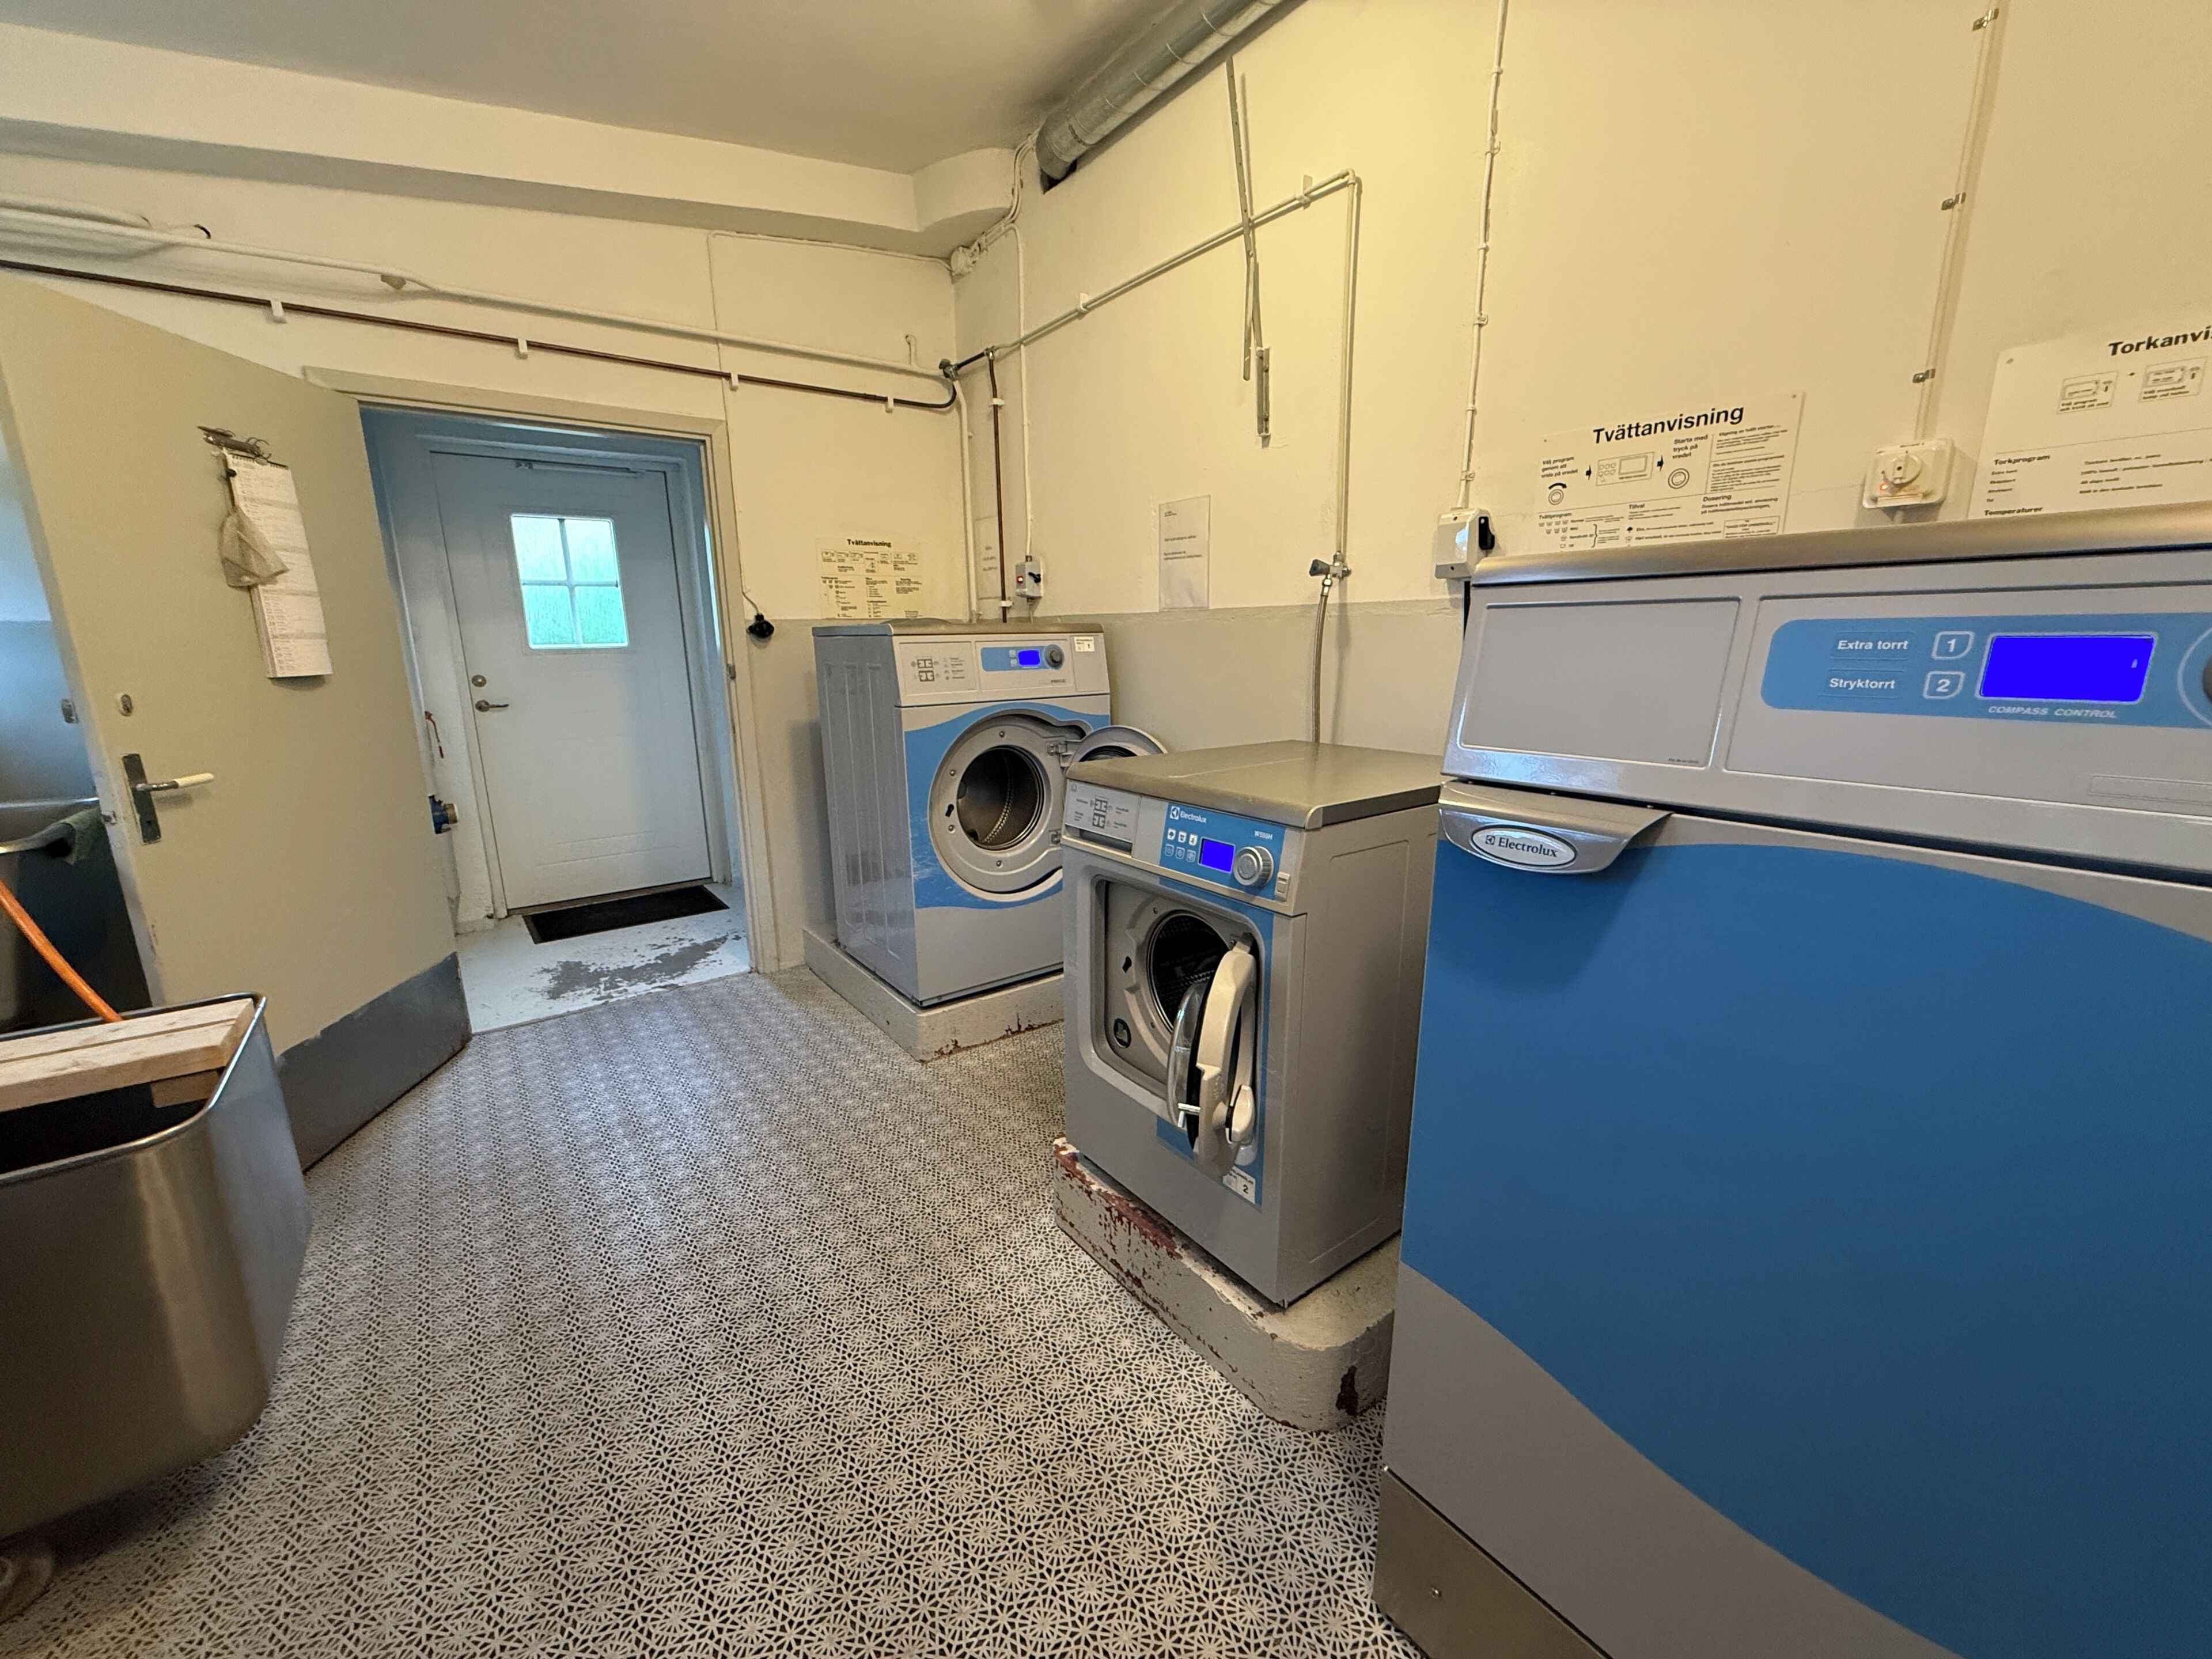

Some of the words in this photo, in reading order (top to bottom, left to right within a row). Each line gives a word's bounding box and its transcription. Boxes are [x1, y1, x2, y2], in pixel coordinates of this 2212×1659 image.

[2109, 326, 2212, 355] Torkanvi
[1593, 406, 1744, 444] Tvättanvisning
[1994, 455, 2051, 465] Torkprogram
[1984, 506, 2043, 516] Temperaturer
[847, 539, 892, 547] Tvättanvisning
[1838, 638, 1873, 651] Extra
[1877, 638, 1909, 650] torrt
[1946, 639, 1956, 652] 1
[1829, 677, 1896, 690] Stryktorrt
[1936, 680, 1950, 692] 2
[1988, 704, 2049, 716] COMPASS
[2054, 708, 2118, 719] CONTROL
[1180, 810, 1207, 824] Electrolux
[1498, 837, 1558, 858] Electrolux
[1243, 1184, 1248, 1194] 2
